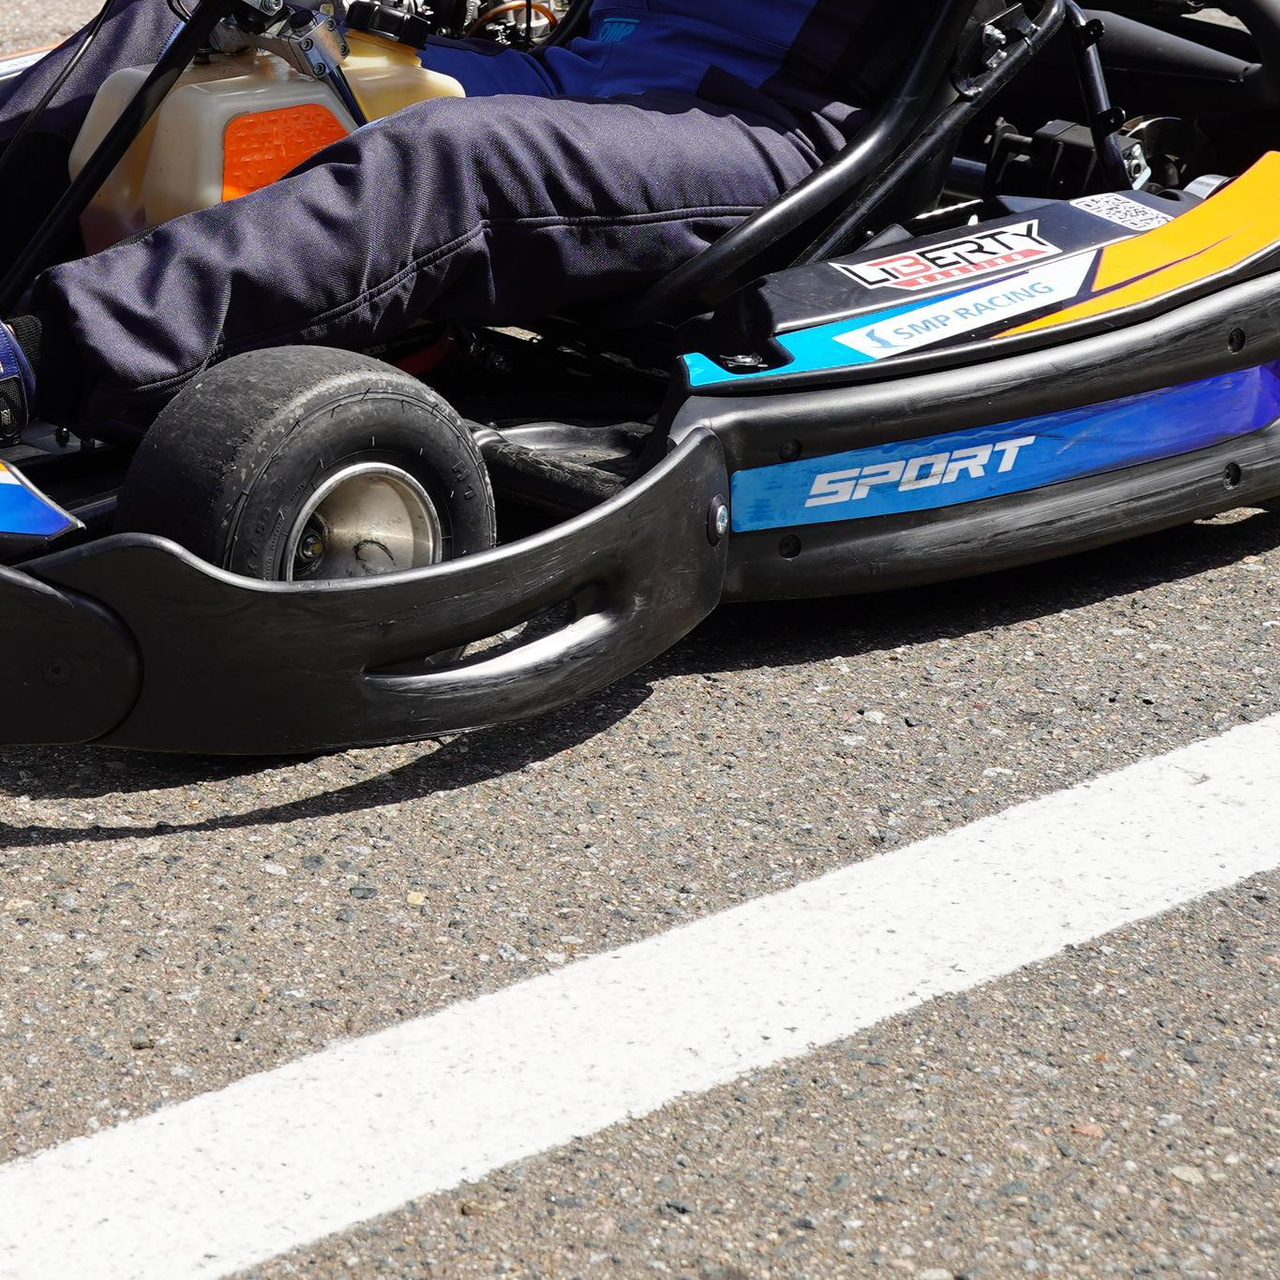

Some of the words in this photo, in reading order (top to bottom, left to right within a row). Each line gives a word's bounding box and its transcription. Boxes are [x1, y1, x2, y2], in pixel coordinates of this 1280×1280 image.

[838, 222, 1049, 286] LIBERTY
[915, 253, 1026, 285] KARTING
[893, 314, 949, 340] SMP
[959, 281, 1055, 320] RACING
[804, 435, 1036, 508] SPORT
